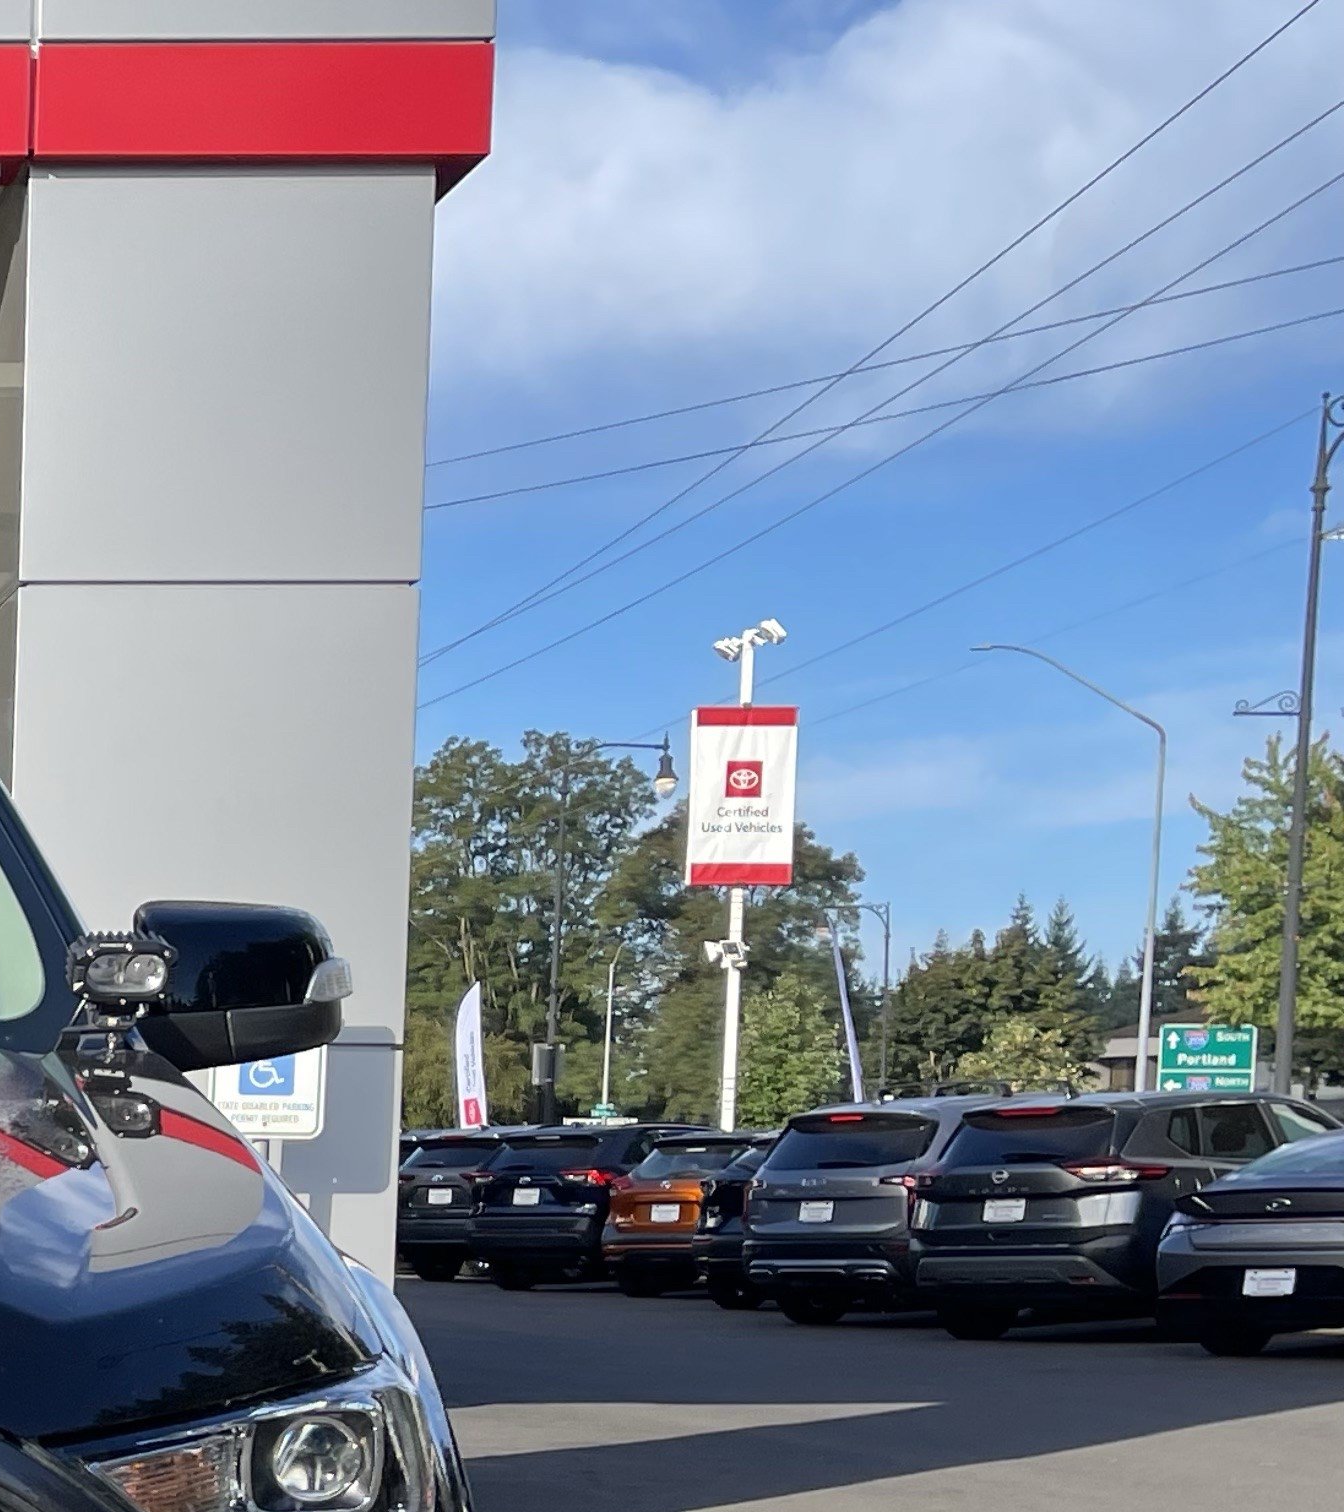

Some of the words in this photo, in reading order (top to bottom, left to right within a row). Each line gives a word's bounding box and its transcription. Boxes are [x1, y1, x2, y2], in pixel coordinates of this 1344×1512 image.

[717, 805, 769, 817] Certified
[701, 821, 732, 833] Used
[734, 821, 783, 833] Vehicles
[1176, 1052, 1237, 1066] Portland
[282, 1102, 315, 1112] PARKING
